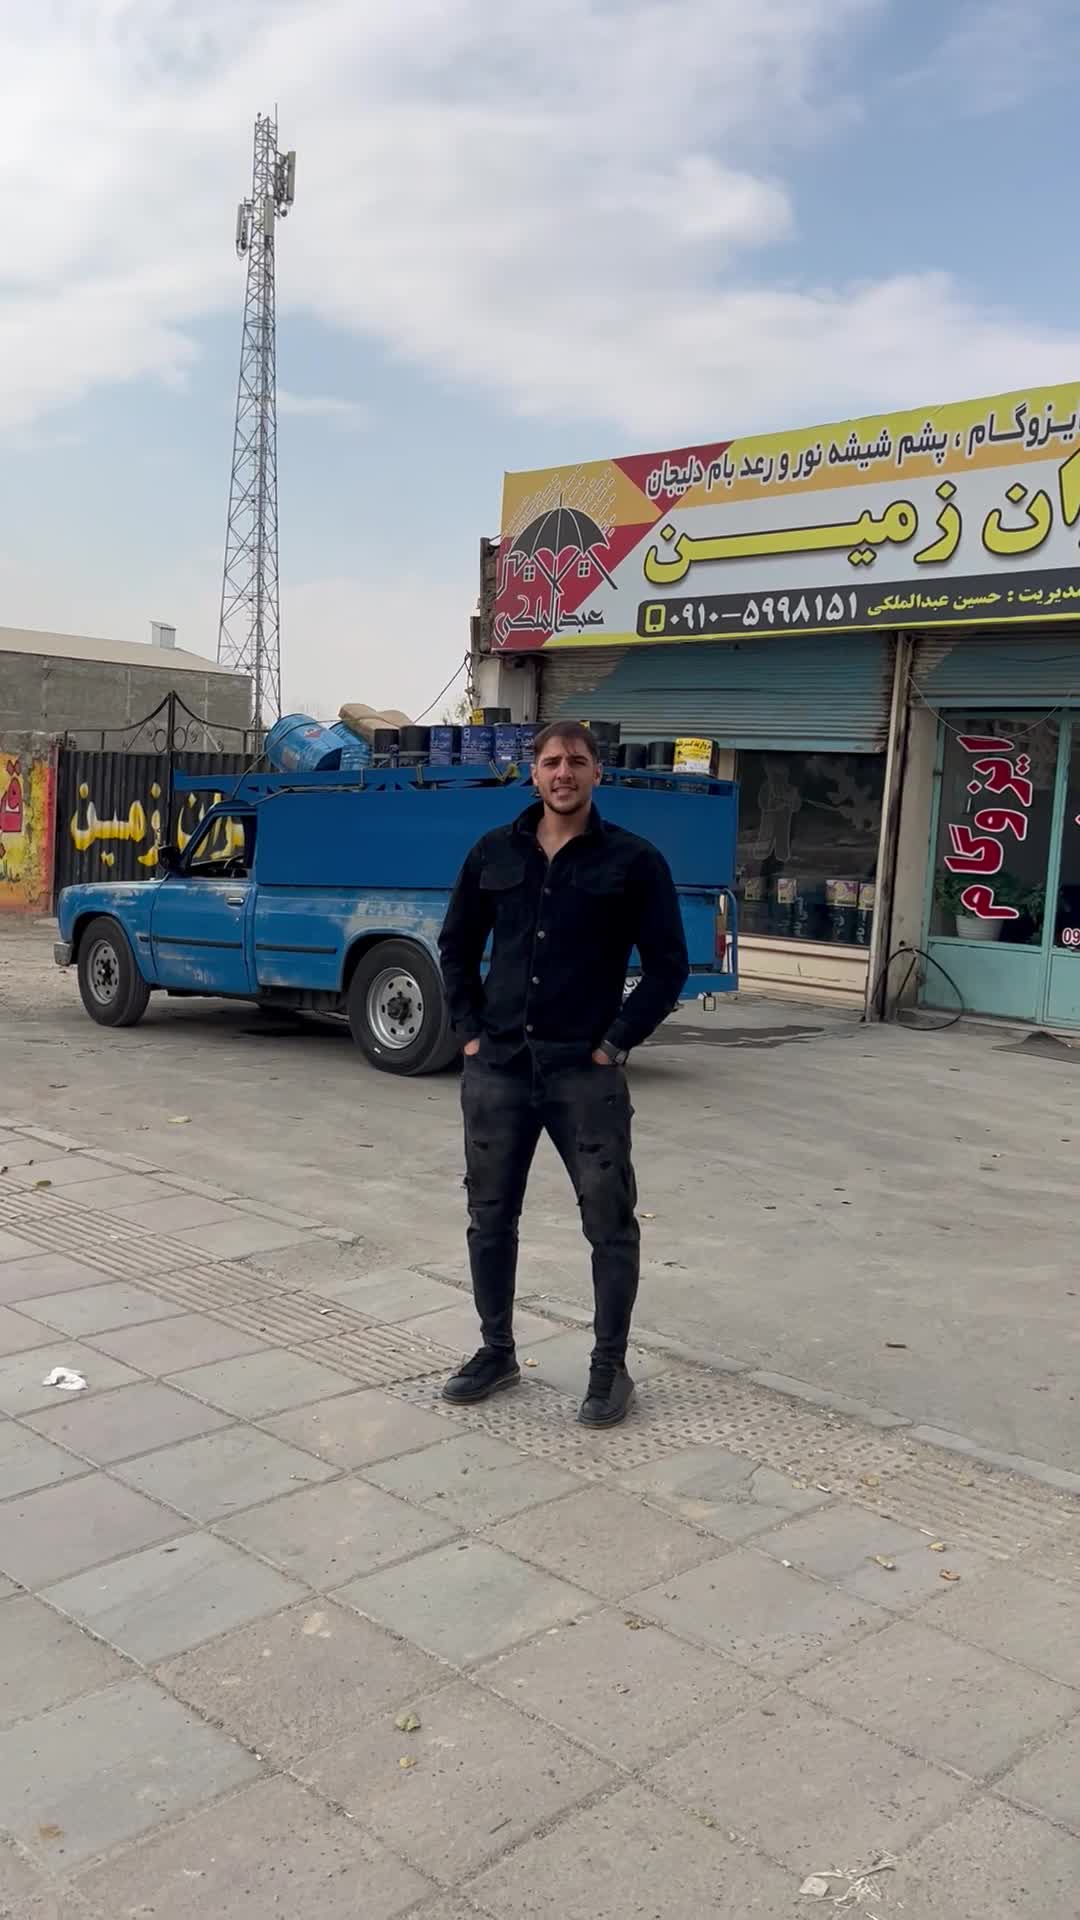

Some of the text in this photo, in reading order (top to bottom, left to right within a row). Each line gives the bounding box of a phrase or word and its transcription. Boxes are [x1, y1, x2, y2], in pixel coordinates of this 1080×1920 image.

[897, 422, 947, 464] پشم
[967, 402, 1080, 456] یزوگام
[778, 453, 788, 480] و
[792, 443, 822, 478] نور
[829, 429, 892, 468] شیشه
[647, 458, 703, 497] دلیجان
[708, 453, 734, 489] بام
[740, 455, 773, 482] رعد
[643, 480, 963, 584] زمین
[867, 593, 949, 616] عبدالملکی
[953, 591, 1002, 610] حسین
[944, 735, 1033, 919] ایزوگام
